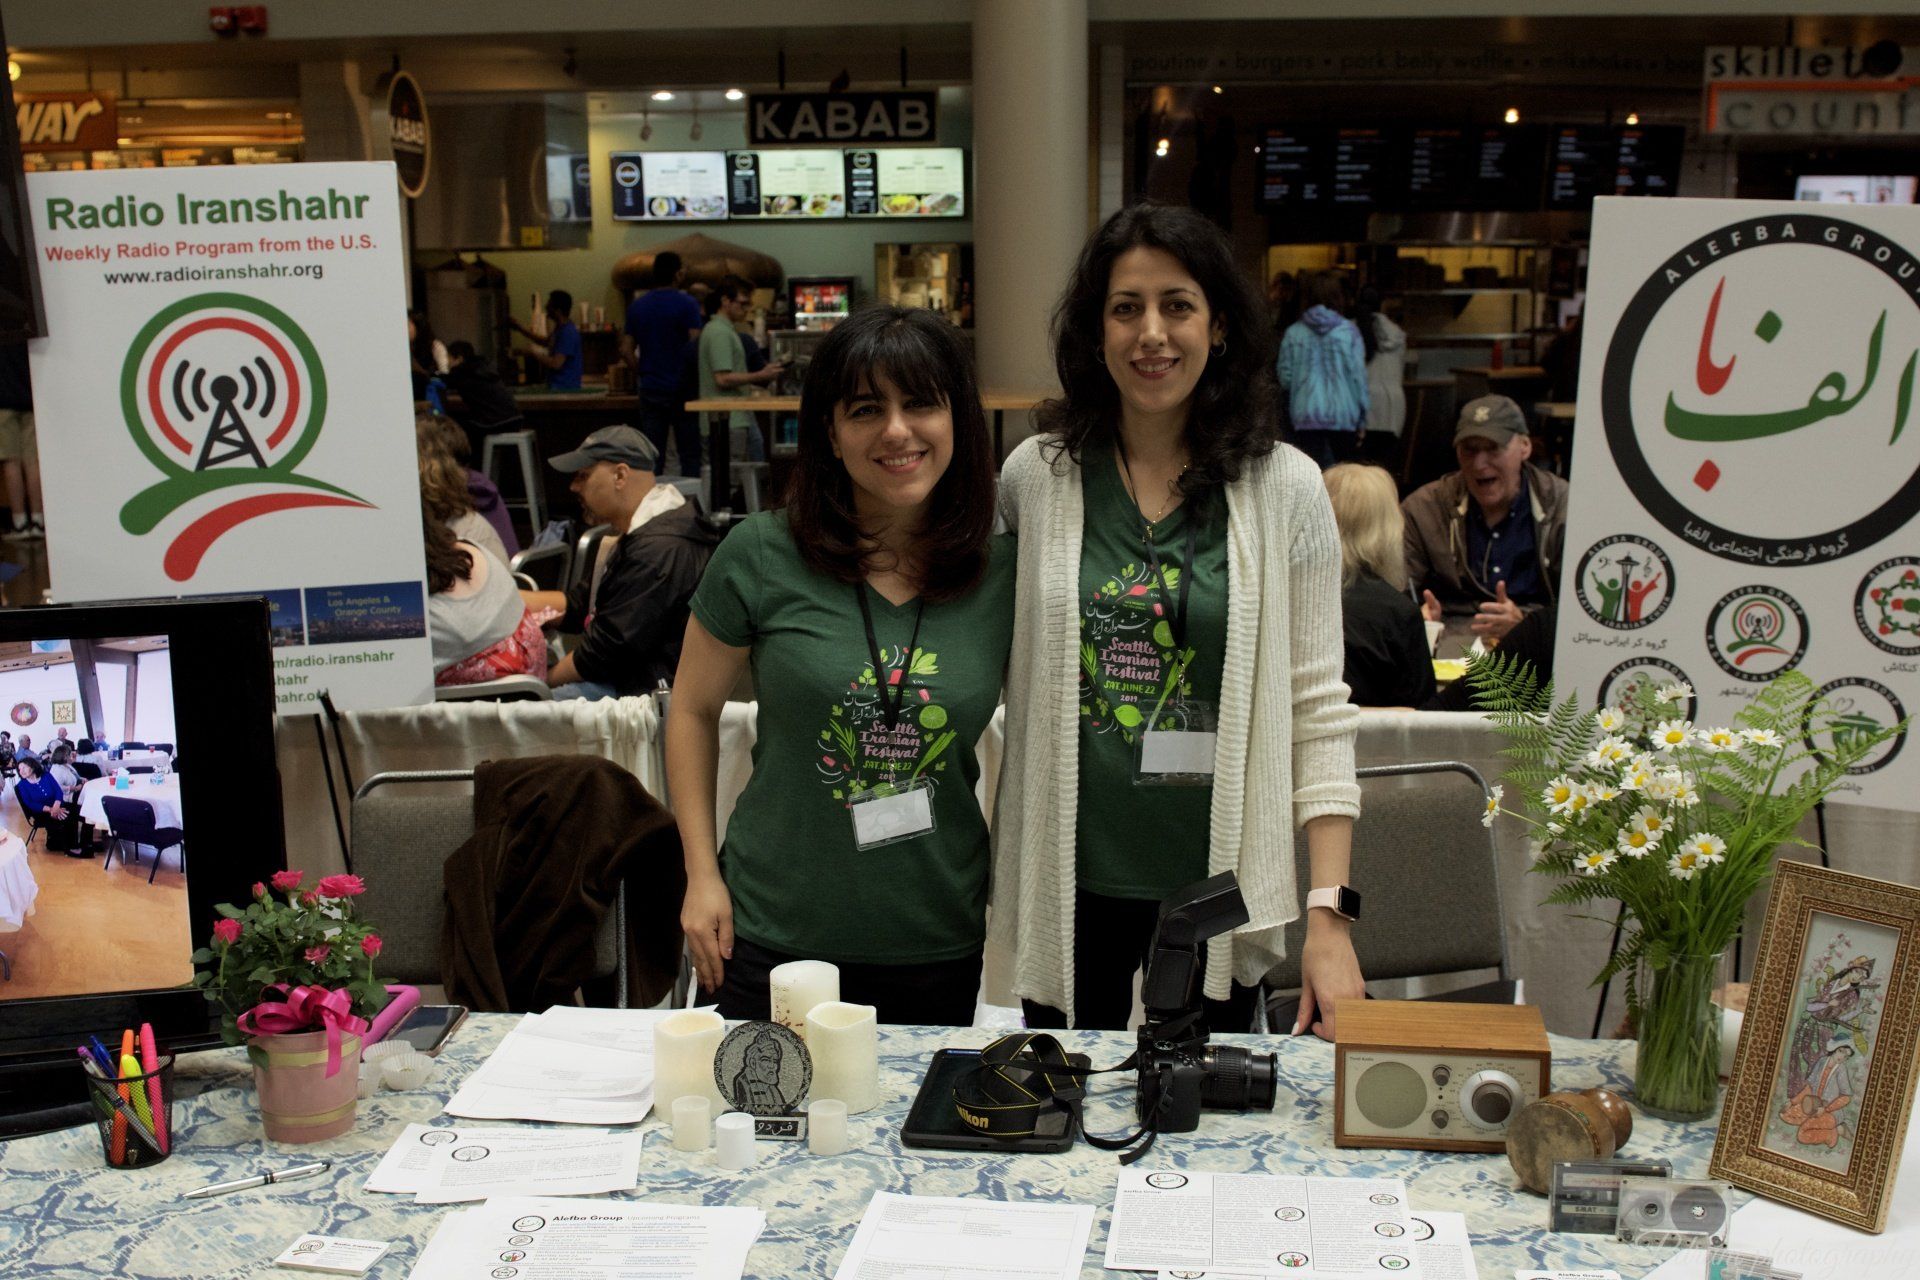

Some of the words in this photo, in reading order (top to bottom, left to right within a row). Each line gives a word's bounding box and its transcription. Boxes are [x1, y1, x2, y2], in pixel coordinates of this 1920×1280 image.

[1235, 51, 1314, 75] burgers
[1709, 47, 1862, 78] skillet
[755, 100, 930, 140] KABAB
[46, 195, 164, 230] Radio
[177, 188, 370, 225] Iranshahr
[45, 245, 111, 263] Weekly
[117, 243, 170, 259] Radio
[175, 240, 253, 258] Program
[259, 237, 300, 253] from
[306, 236, 335, 251] the
[341, 234, 377, 249] U.S.
[1665, 222, 1797, 284] ALEFBA
[1823, 226, 1920, 294] GROU
[104, 262, 324, 285] www.radioiranshahr.org
[1588, 535, 1627, 556] ALEFBA
[1633, 537, 1668, 562] GROUP
[1820, 532, 1848, 557] گروه
[1869, 557, 1910, 581] ALEFBA
[328, 598, 344, 608] Los
[346, 596, 381, 608] Angeles
[1720, 587, 1762, 608] ALEFBA
[335, 607, 368, 618] Orange
[370, 605, 402, 616] County
[1108, 636, 1157, 655] Seattle
[1099, 648, 1161, 668] Iranian
[1102, 663, 1161, 682] Festival
[1120, 694, 1138, 703] 2019
[1121, 682, 1143, 693] JUNE
[1144, 685, 1156, 695] 22
[859, 731, 921, 747] Iraian
[869, 719, 920, 736] Settle
[956, 1104, 989, 1129] Nikon
